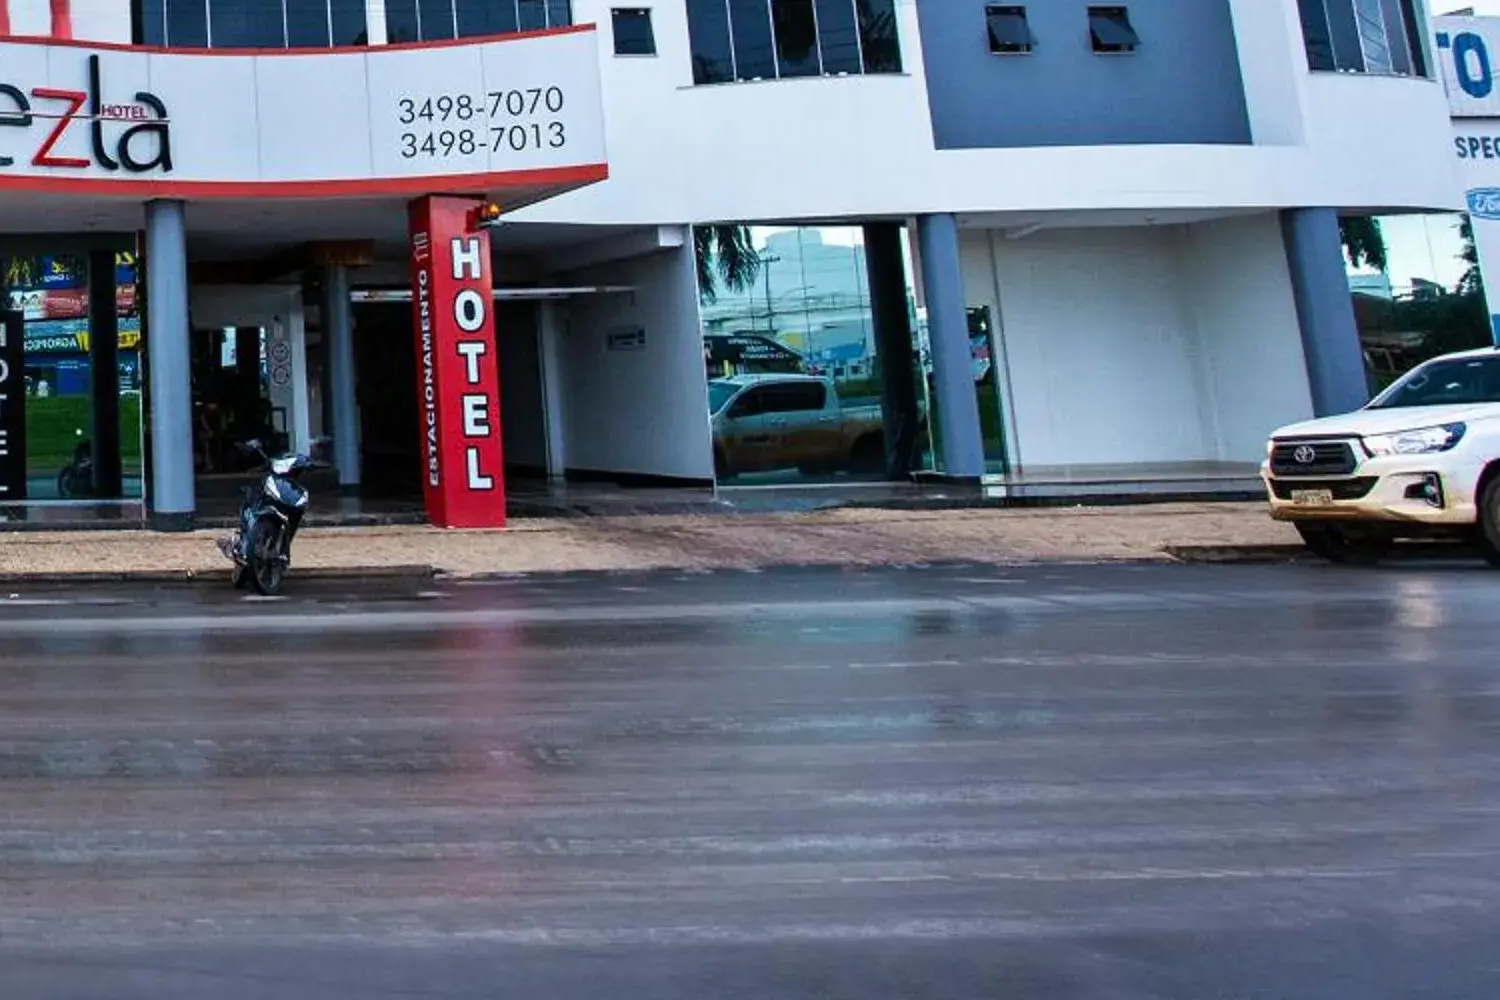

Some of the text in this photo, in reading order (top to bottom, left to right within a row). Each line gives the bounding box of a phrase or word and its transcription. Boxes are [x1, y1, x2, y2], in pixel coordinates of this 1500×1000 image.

[100, 103, 149, 120] HOTEL
[398, 85, 564, 125] 3498-7070
[401, 121, 566, 159] 3498-7013
[418, 268, 440, 487] ESTACIONAMENTO
[451, 236, 493, 491] HOTEL
